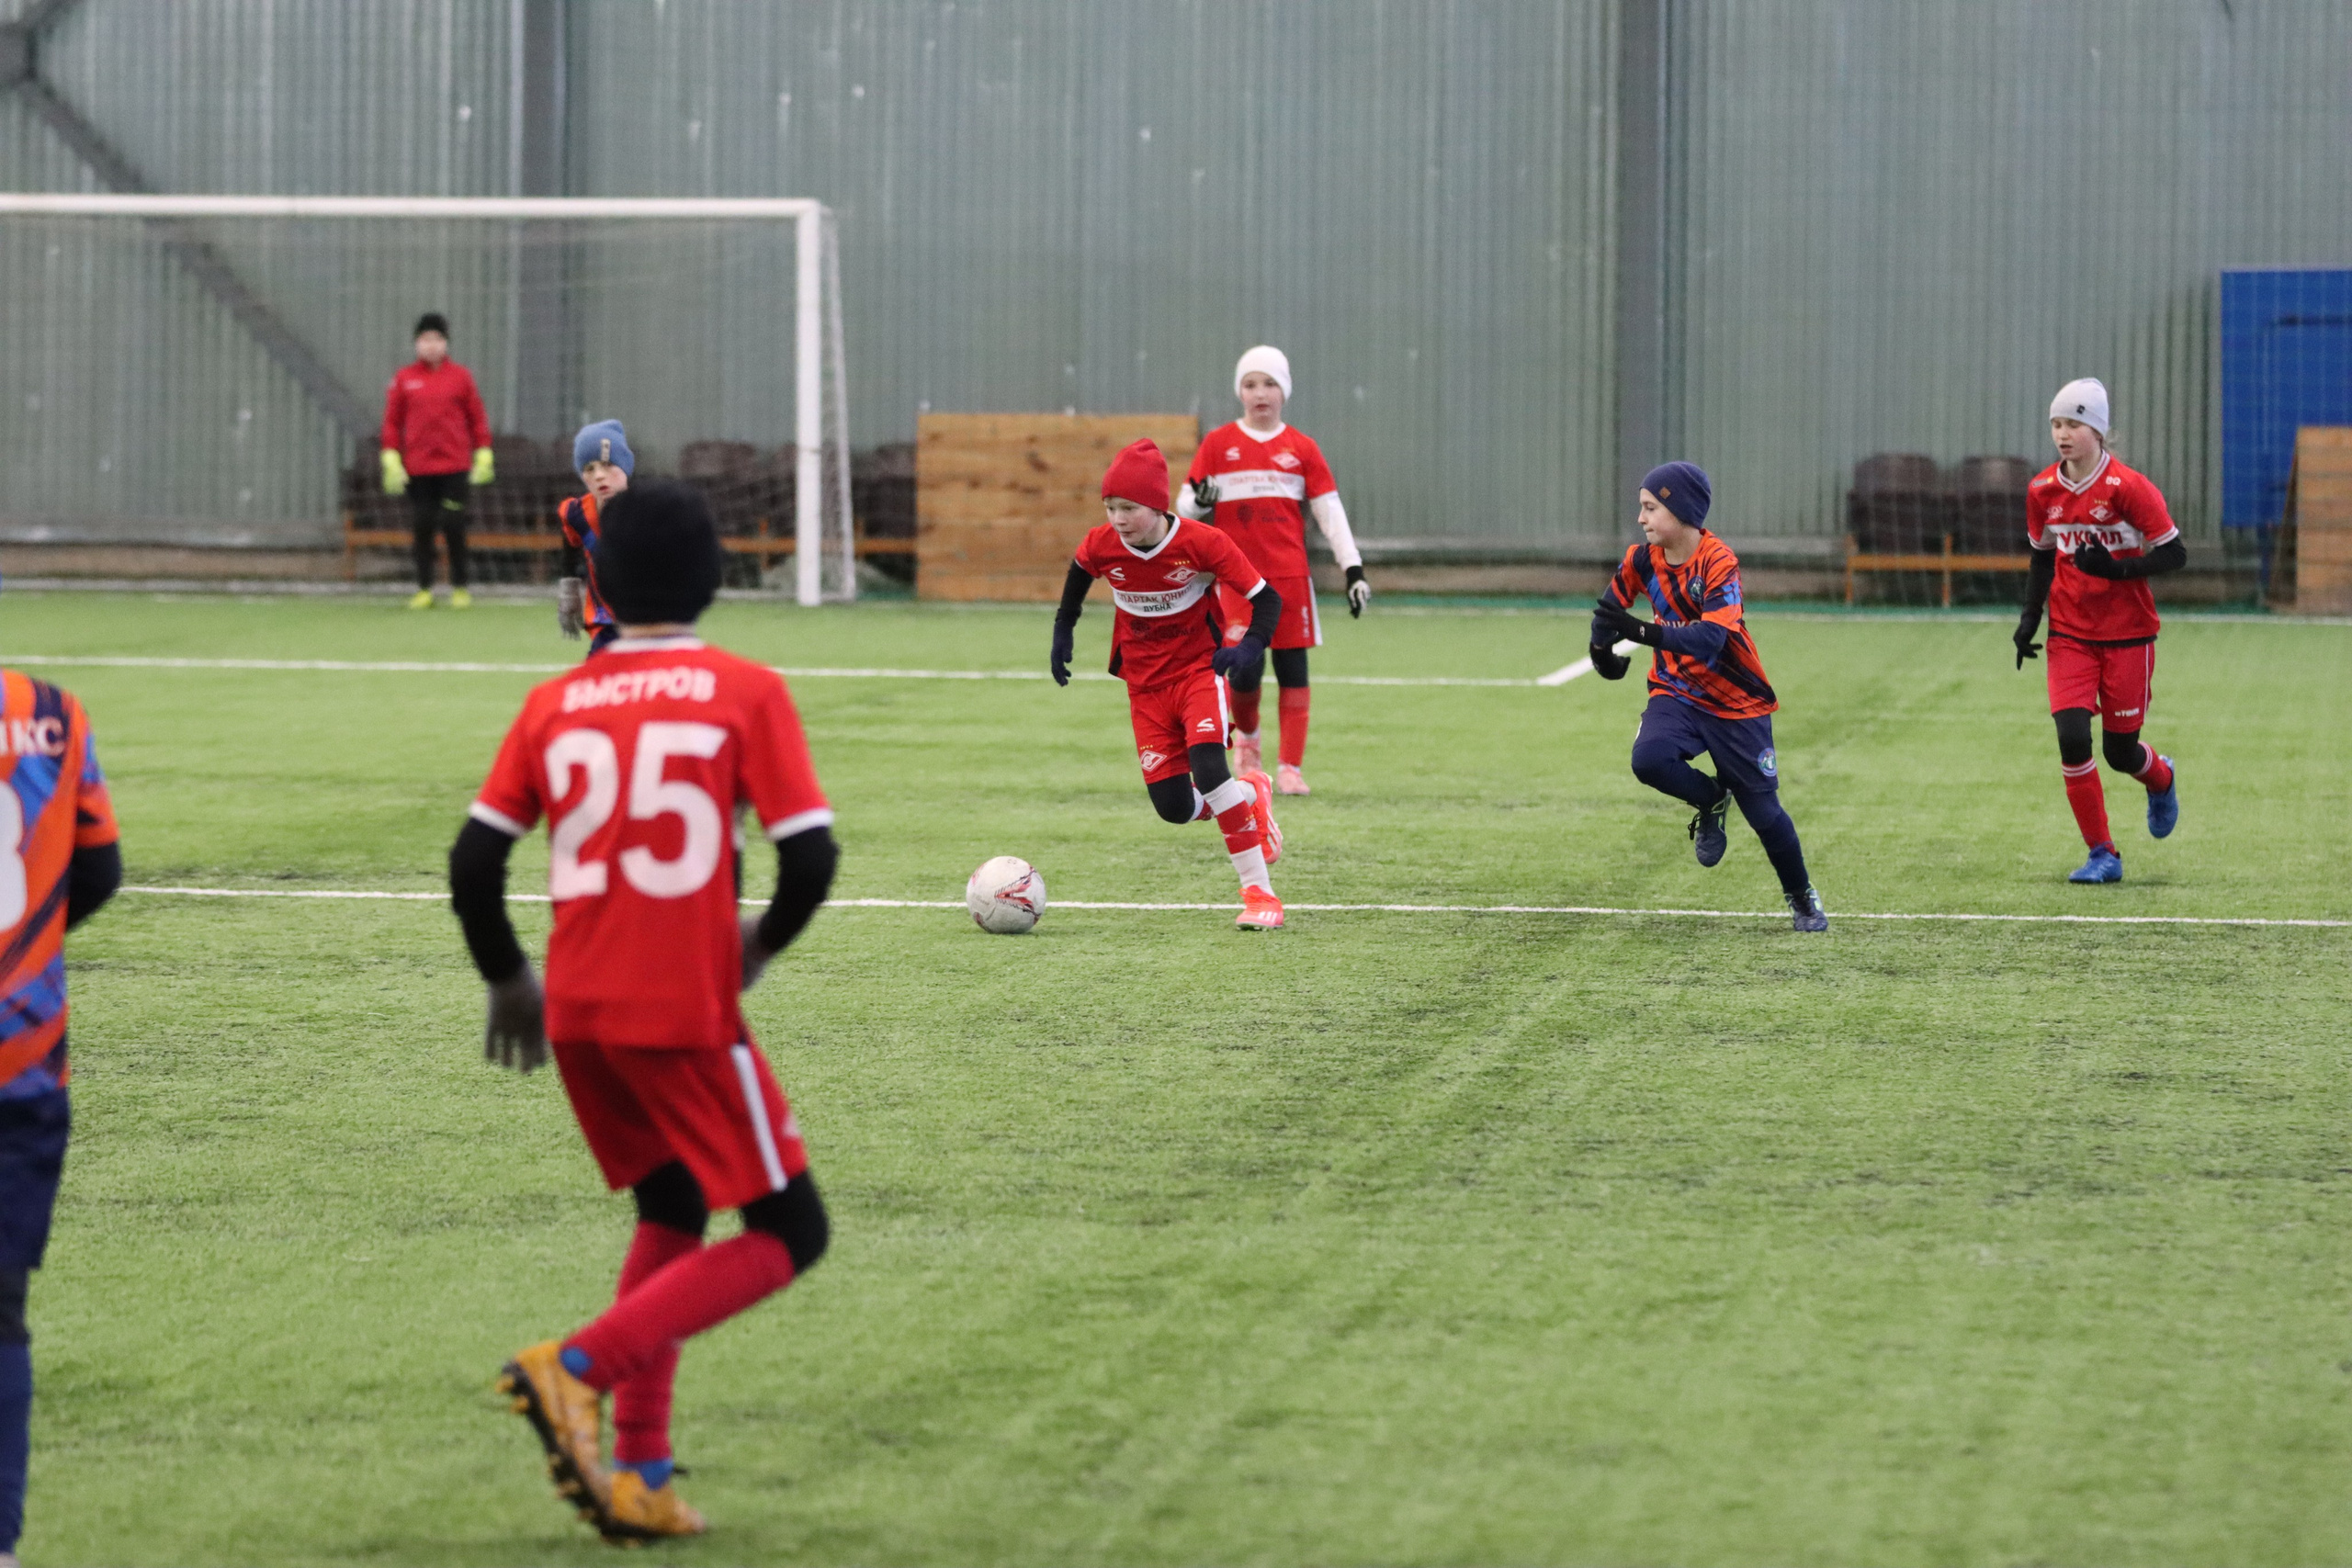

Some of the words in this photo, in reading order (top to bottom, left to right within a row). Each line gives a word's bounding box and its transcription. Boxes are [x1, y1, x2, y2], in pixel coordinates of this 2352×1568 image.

[2054, 527, 2123, 547] УКОЙЛ
[1143, 603, 1172, 613] ДУБНА
[562, 666, 717, 713] БЫСТРОВ
[544, 721, 729, 902] 25
